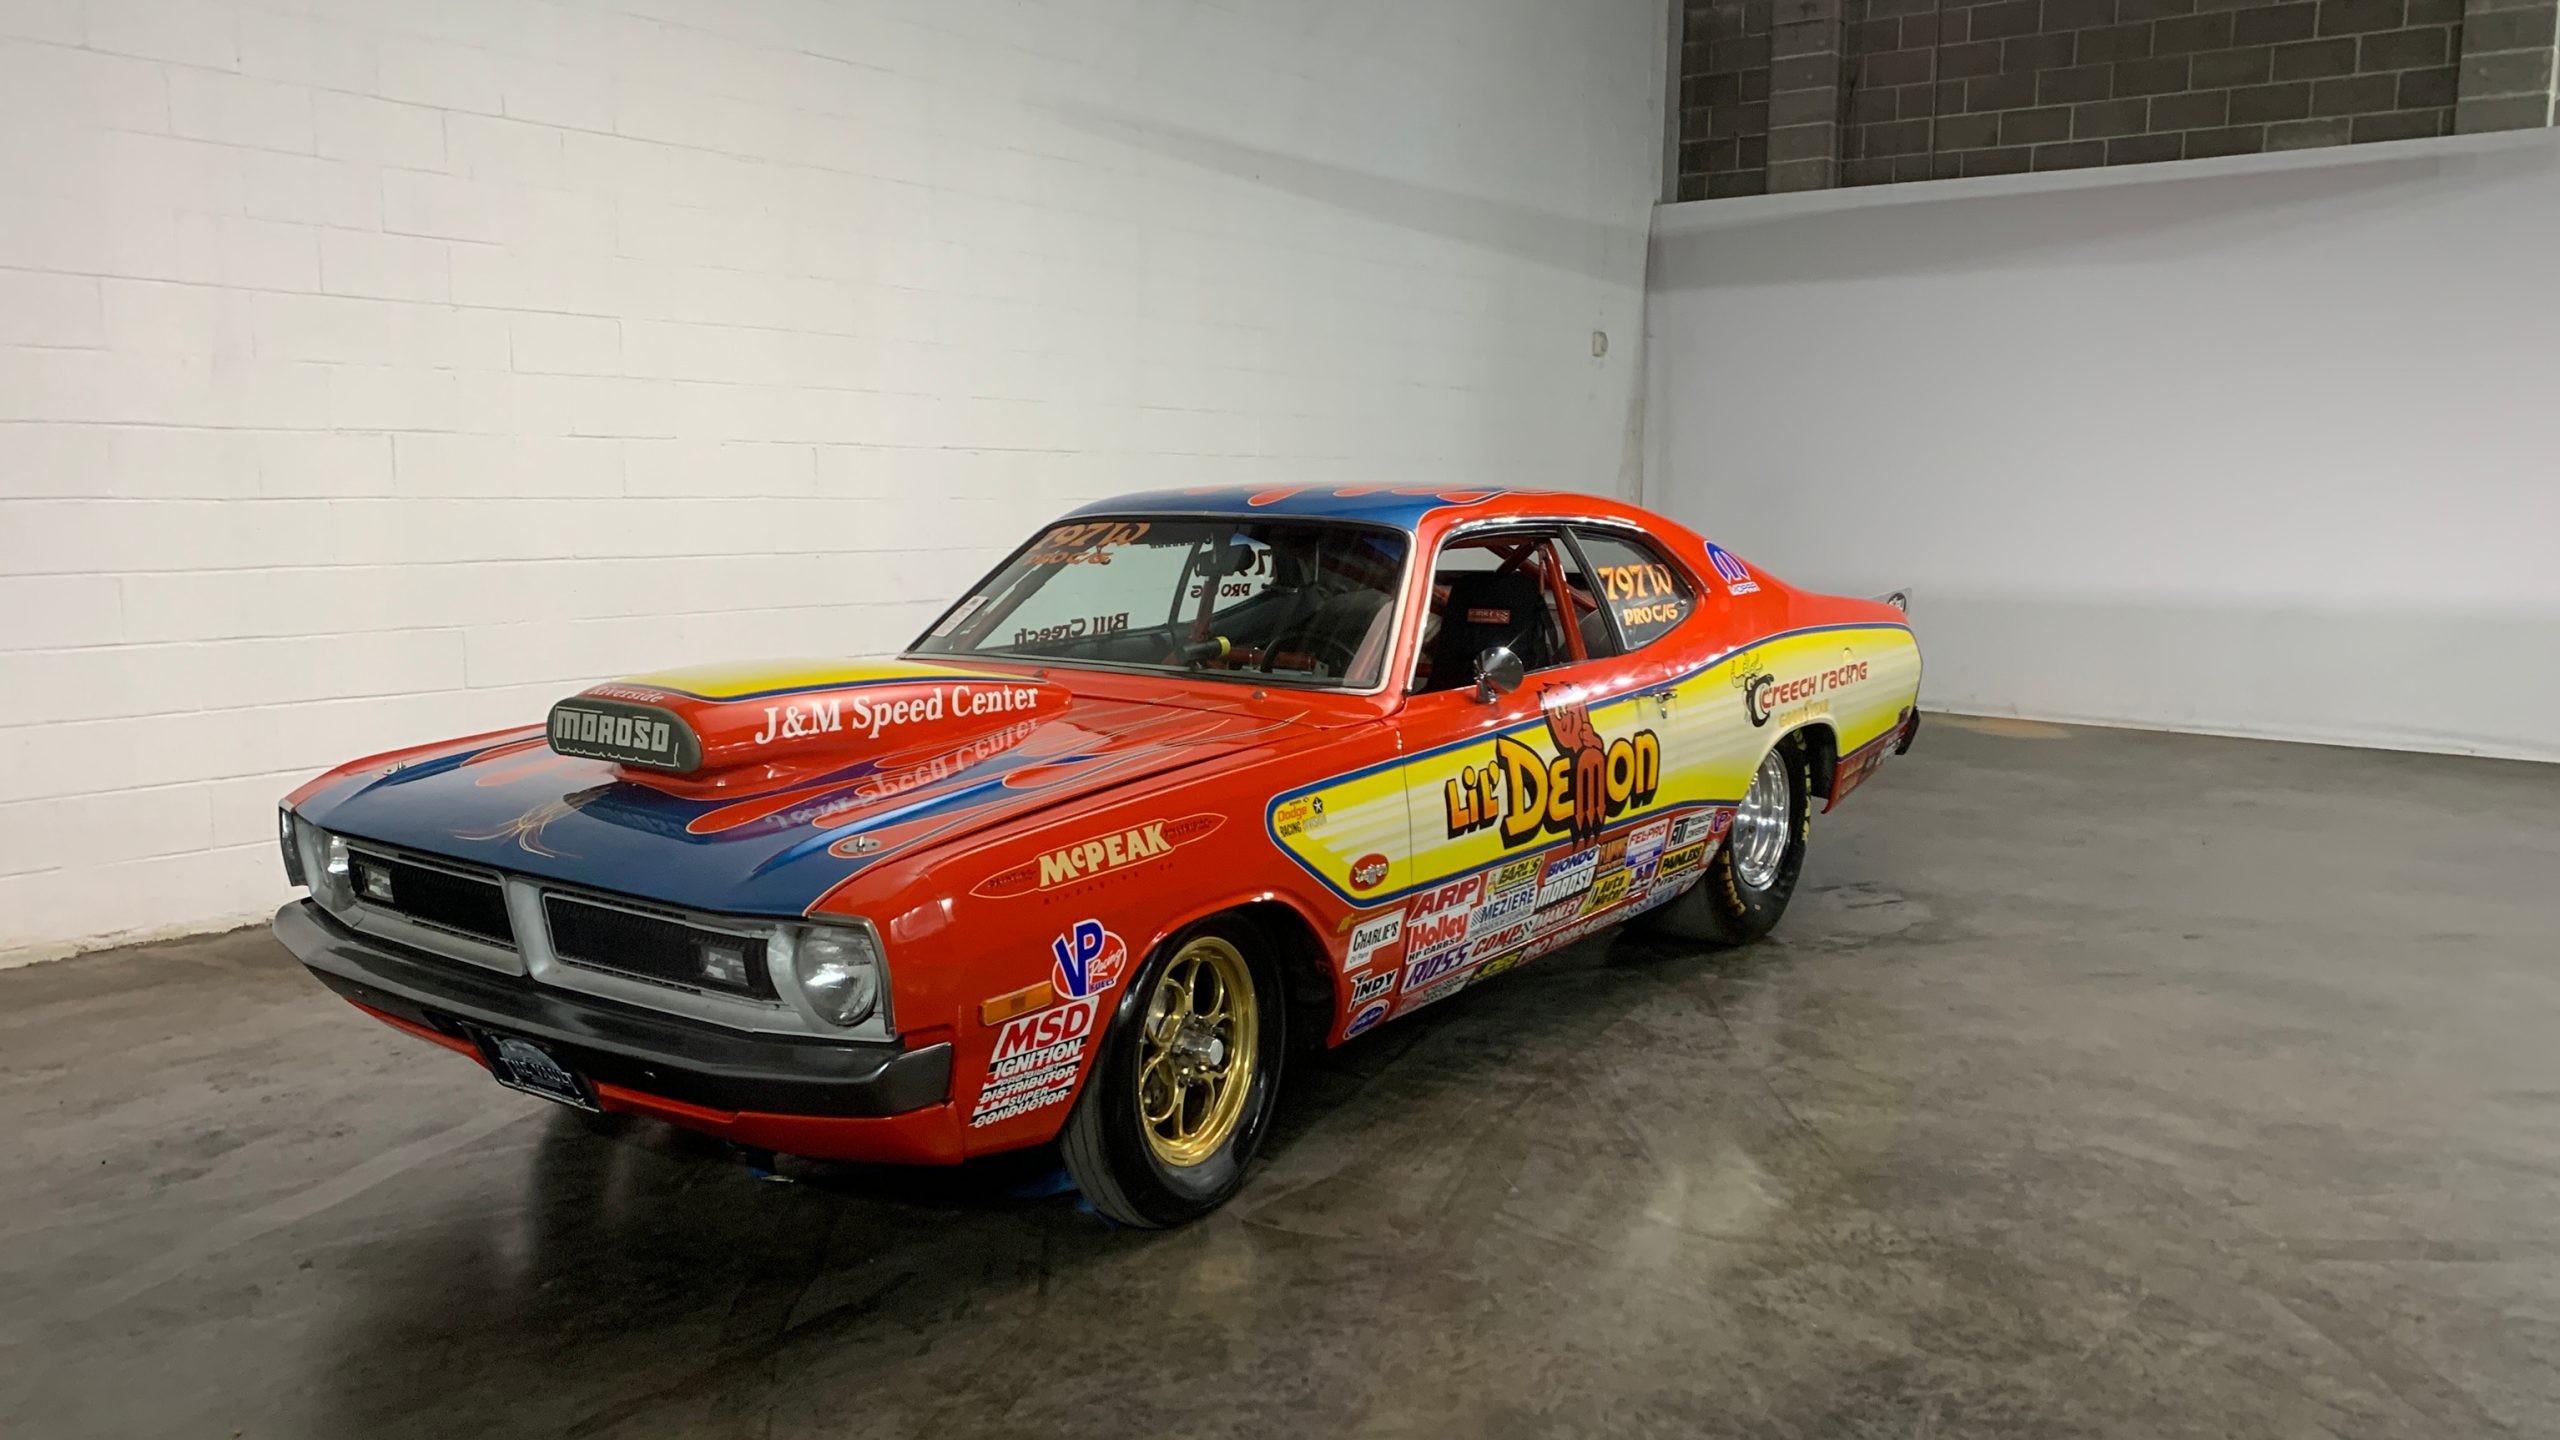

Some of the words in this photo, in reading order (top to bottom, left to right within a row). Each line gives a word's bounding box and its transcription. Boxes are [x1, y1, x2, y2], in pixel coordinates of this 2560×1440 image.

[1598, 563, 1673, 600] 797W
[588, 686, 665, 703] Riverside
[556, 710, 670, 752] MOROSO
[755, 699, 842, 745] J&M
[852, 687, 943, 739] Speed
[952, 684, 1039, 719] Center
[1278, 803, 1307, 822] Dodge
[1547, 849, 1597, 877] BIONDO
[1661, 845, 1704, 873] PAINLESS
[1409, 877, 1480, 920] ARP
[1478, 887, 1535, 924] MEZIERE
[1534, 865, 1597, 910] MOROSO
[1408, 911, 1468, 956] Holley
[1424, 938, 1456, 956] CARBS
[1471, 922, 1523, 958] COMP
[1052, 919, 1105, 998] VP
[1089, 948, 1122, 984] Racing
[1405, 941, 1473, 990] ROSS
[1354, 970, 1396, 1000] INDY
[1000, 1003, 1091, 1059] MSD
[993, 1037, 1082, 1080] IGNITION
[980, 1065, 1077, 1104] DISTRIBUTOR
[1008, 1087, 1049, 1107] SUPER
[974, 1088, 1069, 1129] CONDUCTOR
